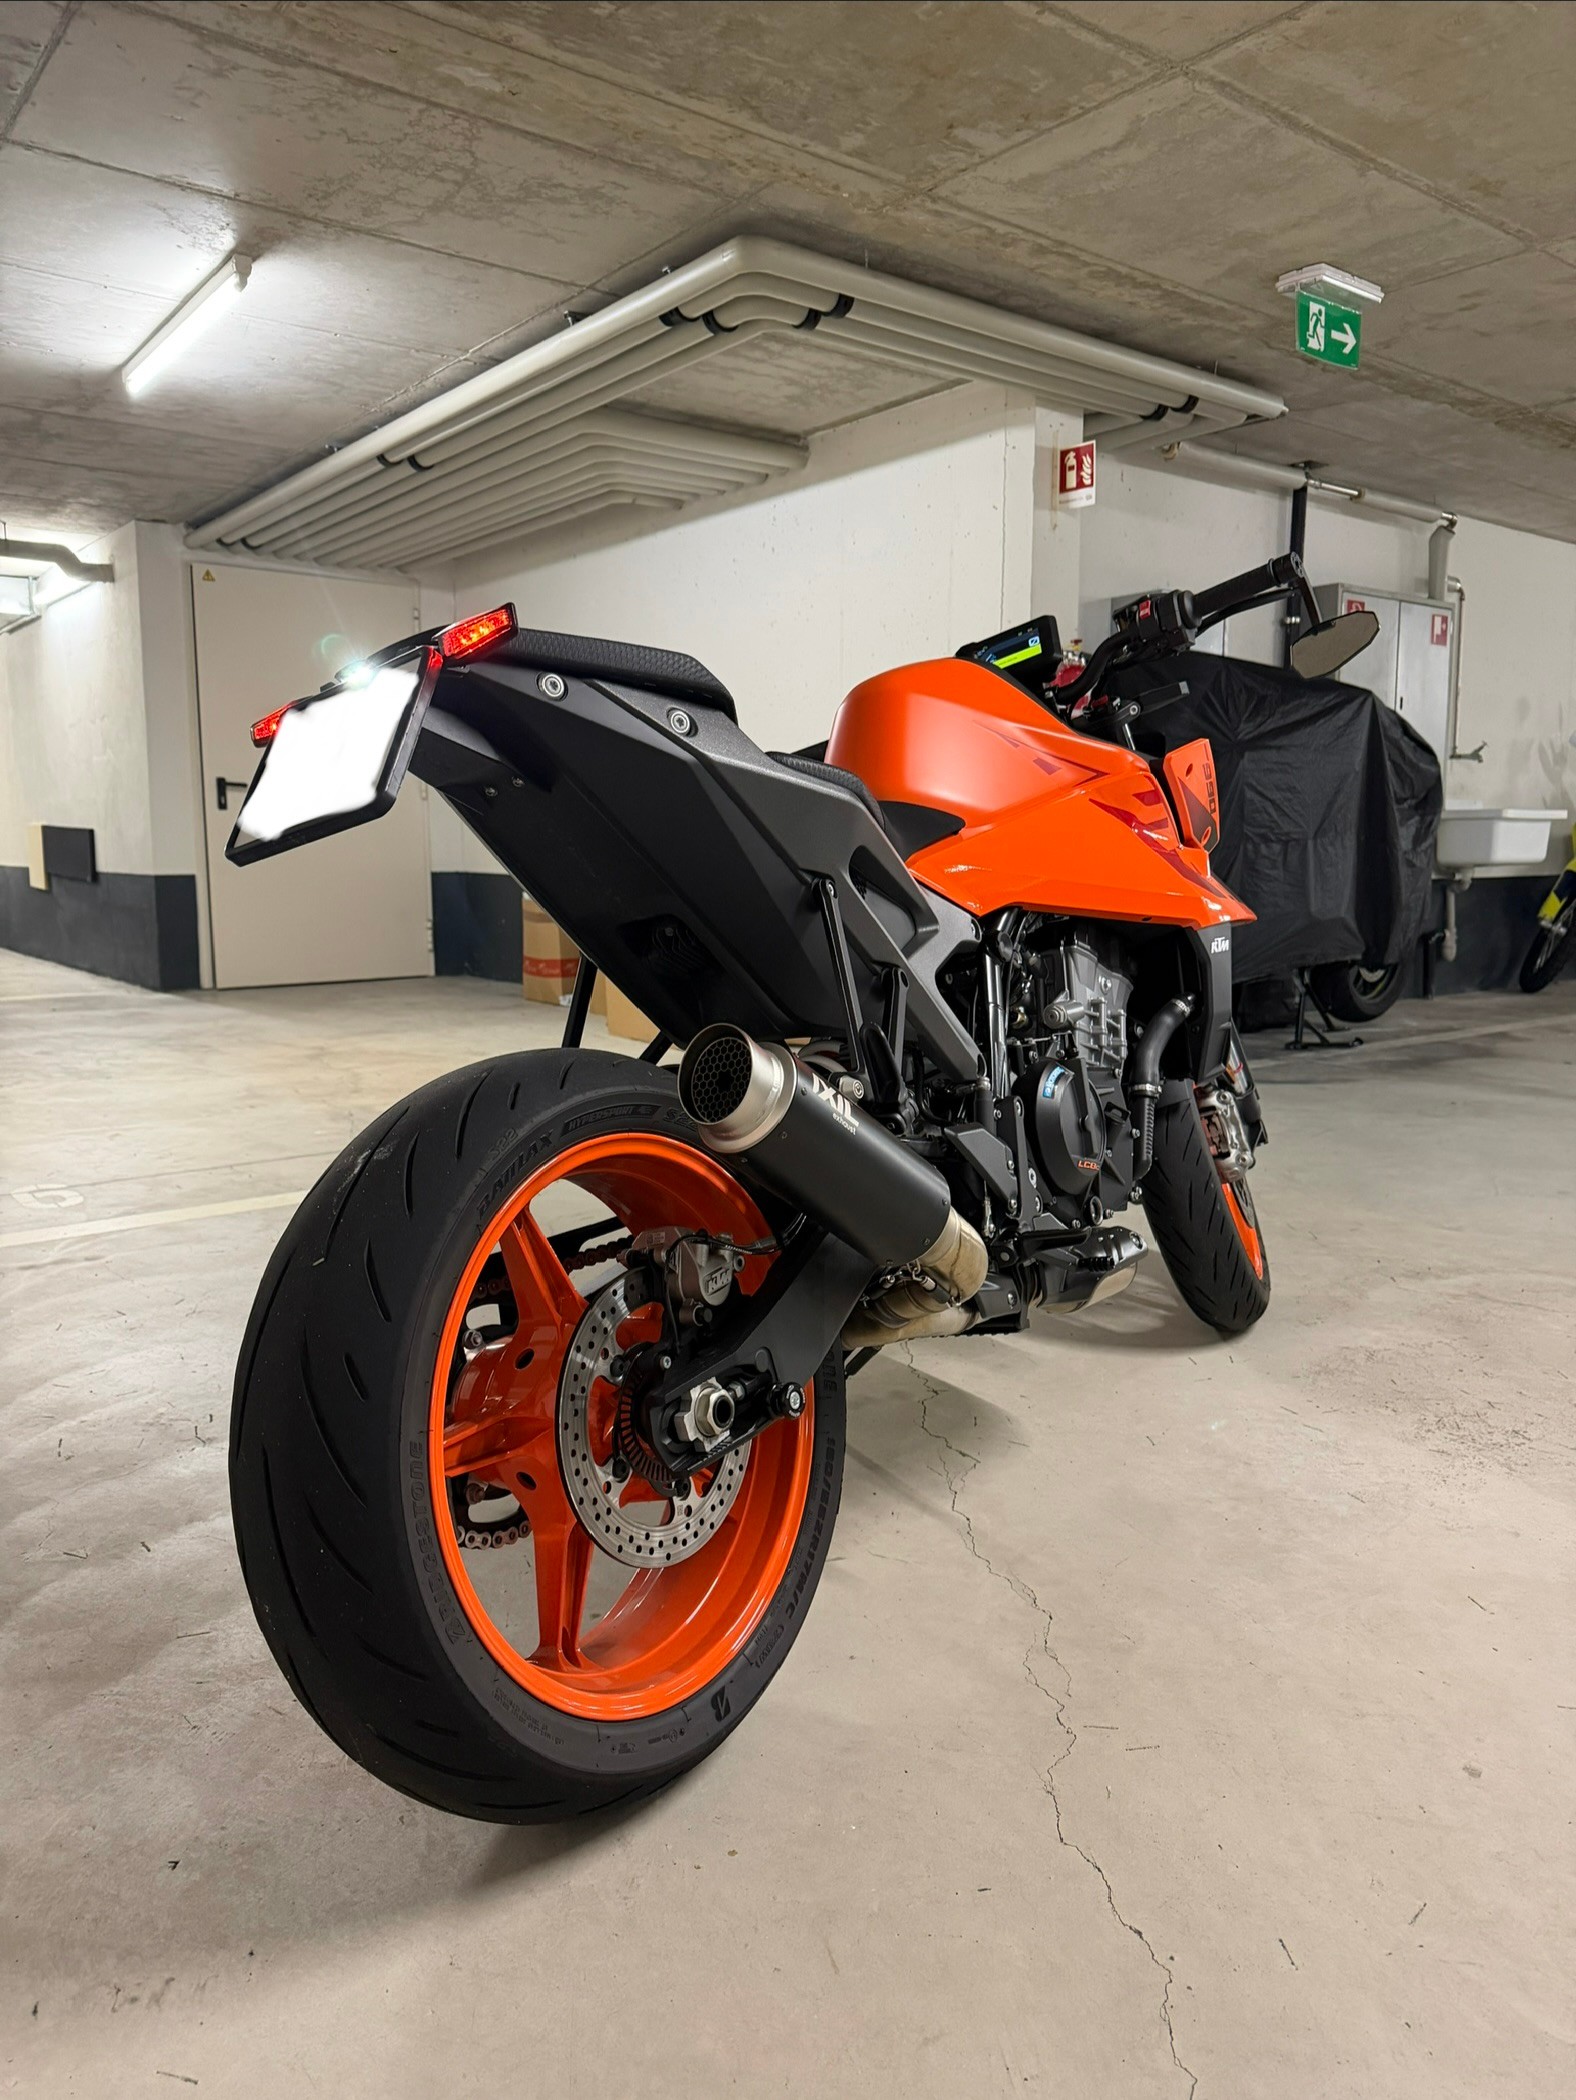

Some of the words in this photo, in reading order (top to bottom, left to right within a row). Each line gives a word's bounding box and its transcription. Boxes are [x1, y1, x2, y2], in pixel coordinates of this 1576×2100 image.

[1203, 763, 1216, 815] 990
[1211, 936, 1230, 954] KTM
[568, 1105, 634, 1132] HYPERSPORT
[832, 1112, 856, 1136] exhaust
[707, 1268, 732, 1294] KTM
[409, 1440, 466, 1645] BRIDGESTONE
